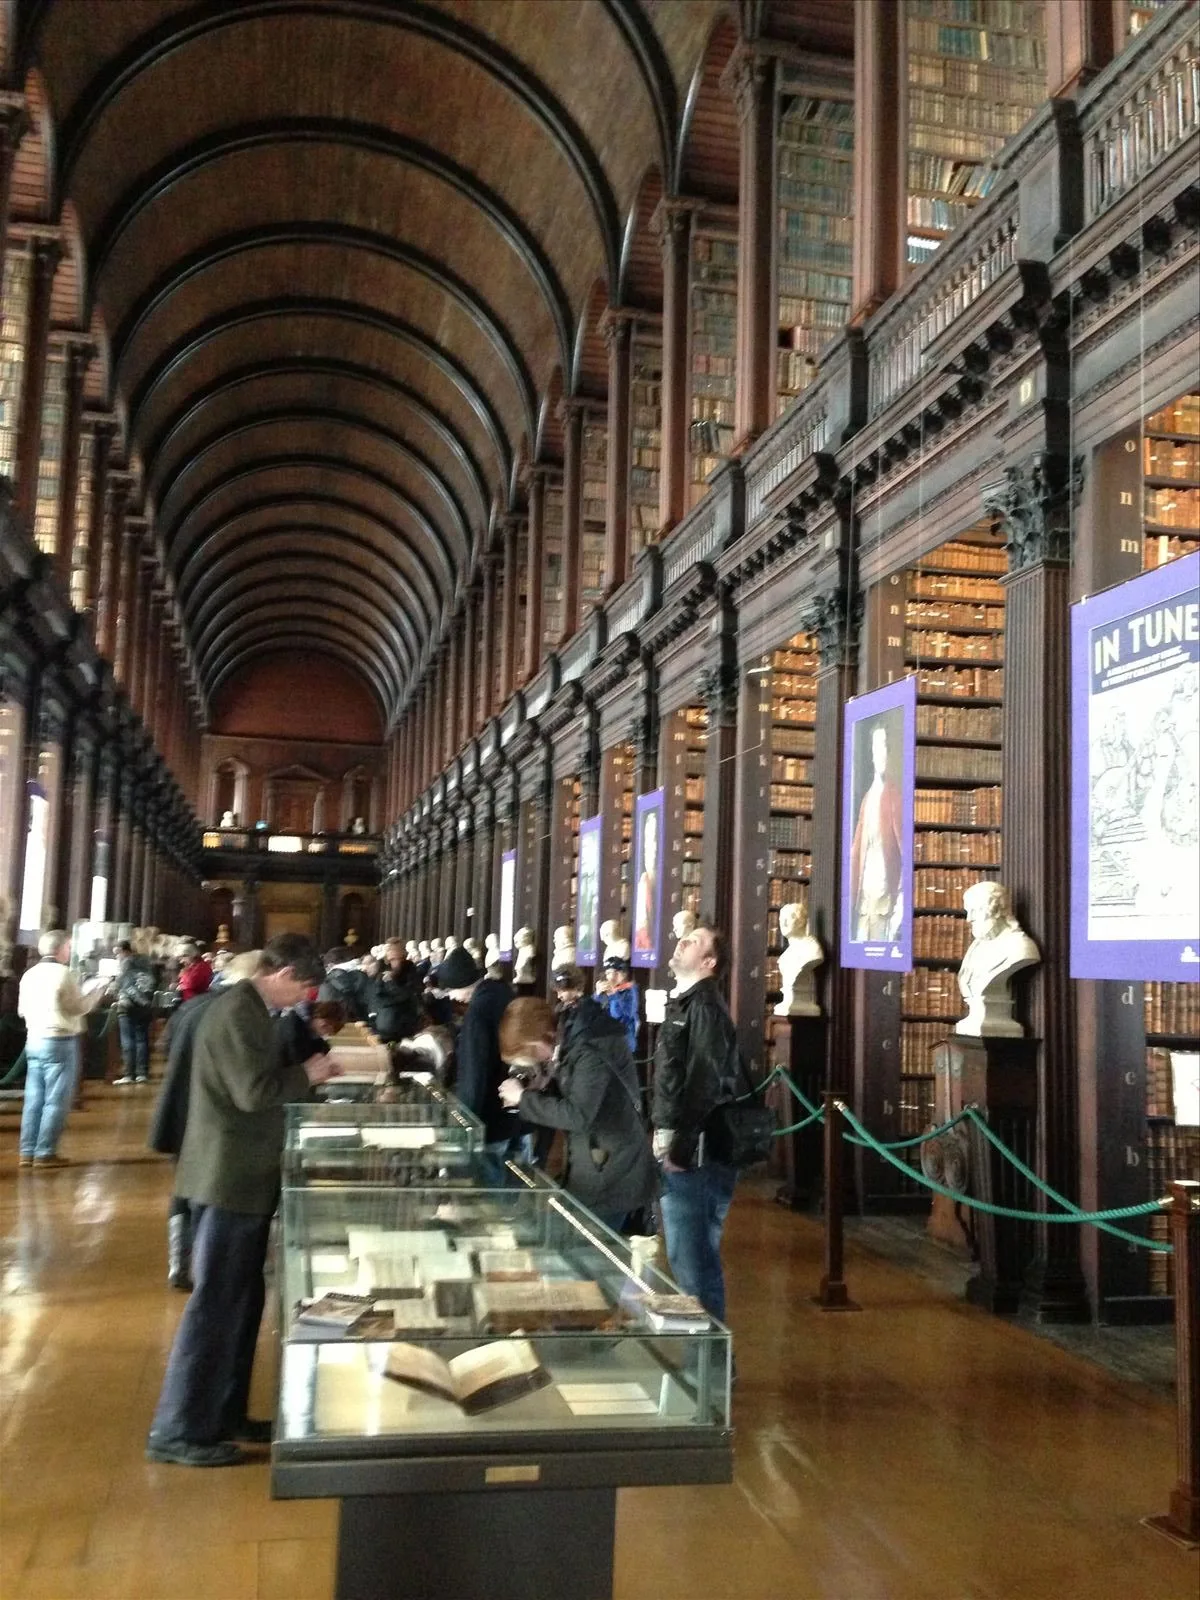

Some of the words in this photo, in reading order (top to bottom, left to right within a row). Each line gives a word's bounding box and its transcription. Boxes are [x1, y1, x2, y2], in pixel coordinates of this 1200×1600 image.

[1124, 440, 1136, 452] o
[1120, 491, 1132, 505] n
[1120, 538, 1139, 553] m
[890, 575, 899, 585] o
[890, 605, 899, 615] n
[888, 636, 901, 646] m
[1094, 628, 1120, 675] IN
[1128, 604, 1200, 654] TUNE
[882, 981, 892, 996] d
[1122, 986, 1134, 1005] d
[1125, 1071, 1136, 1085] c
[1126, 1146, 1139, 1167] b
